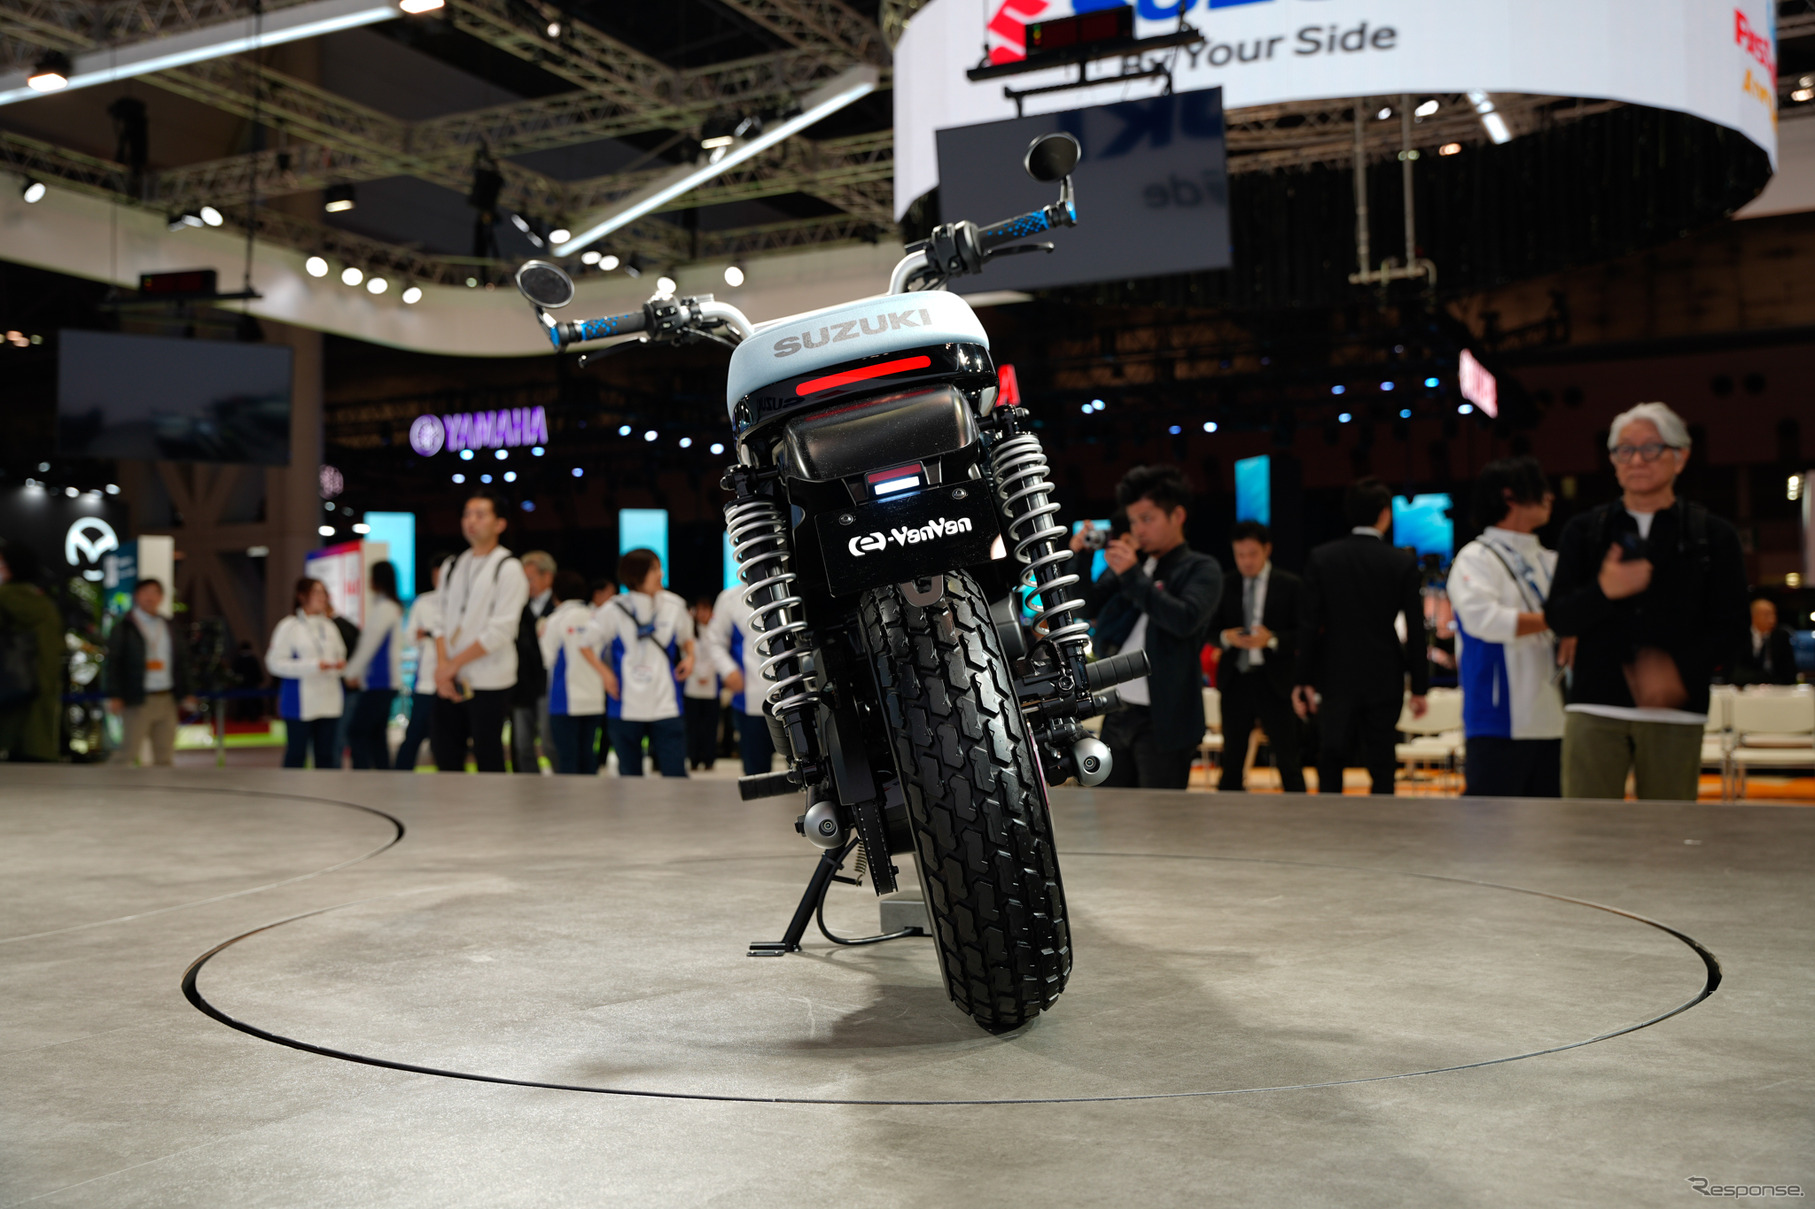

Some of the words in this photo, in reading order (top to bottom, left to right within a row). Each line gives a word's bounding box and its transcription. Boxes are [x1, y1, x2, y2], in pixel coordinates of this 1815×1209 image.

[1184, 33, 1284, 69] Your
[1294, 20, 1397, 56] Side
[773, 308, 932, 358] SUZUKI
[442, 405, 549, 452] YAMAHA
